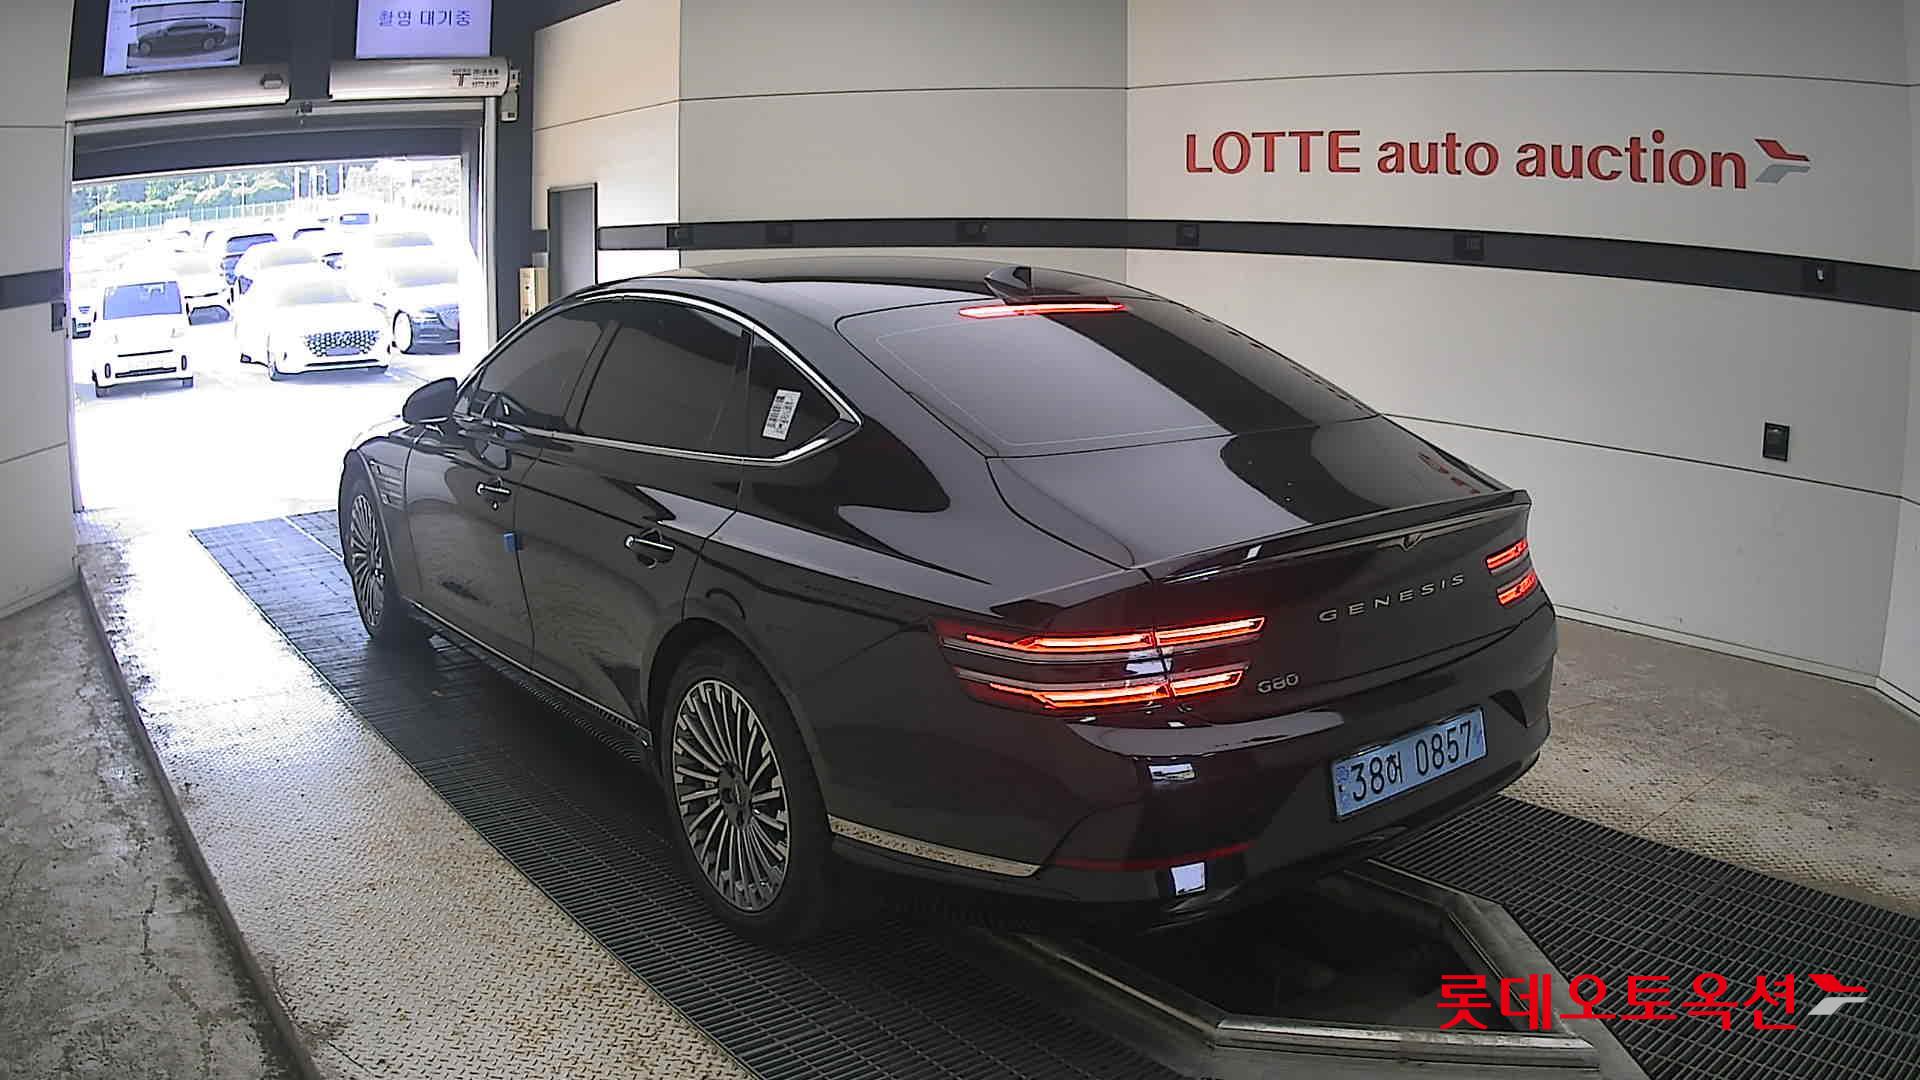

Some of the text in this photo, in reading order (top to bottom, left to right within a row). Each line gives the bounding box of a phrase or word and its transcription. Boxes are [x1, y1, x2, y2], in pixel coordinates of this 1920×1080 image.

[420, 10, 471, 26] 대기중
[1185, 130, 1746, 190] LOTTE auto auction
[1319, 574, 1465, 622] GENESIS
[1258, 673, 1299, 694] G80
[1350, 720, 1471, 801] 38허 0857
